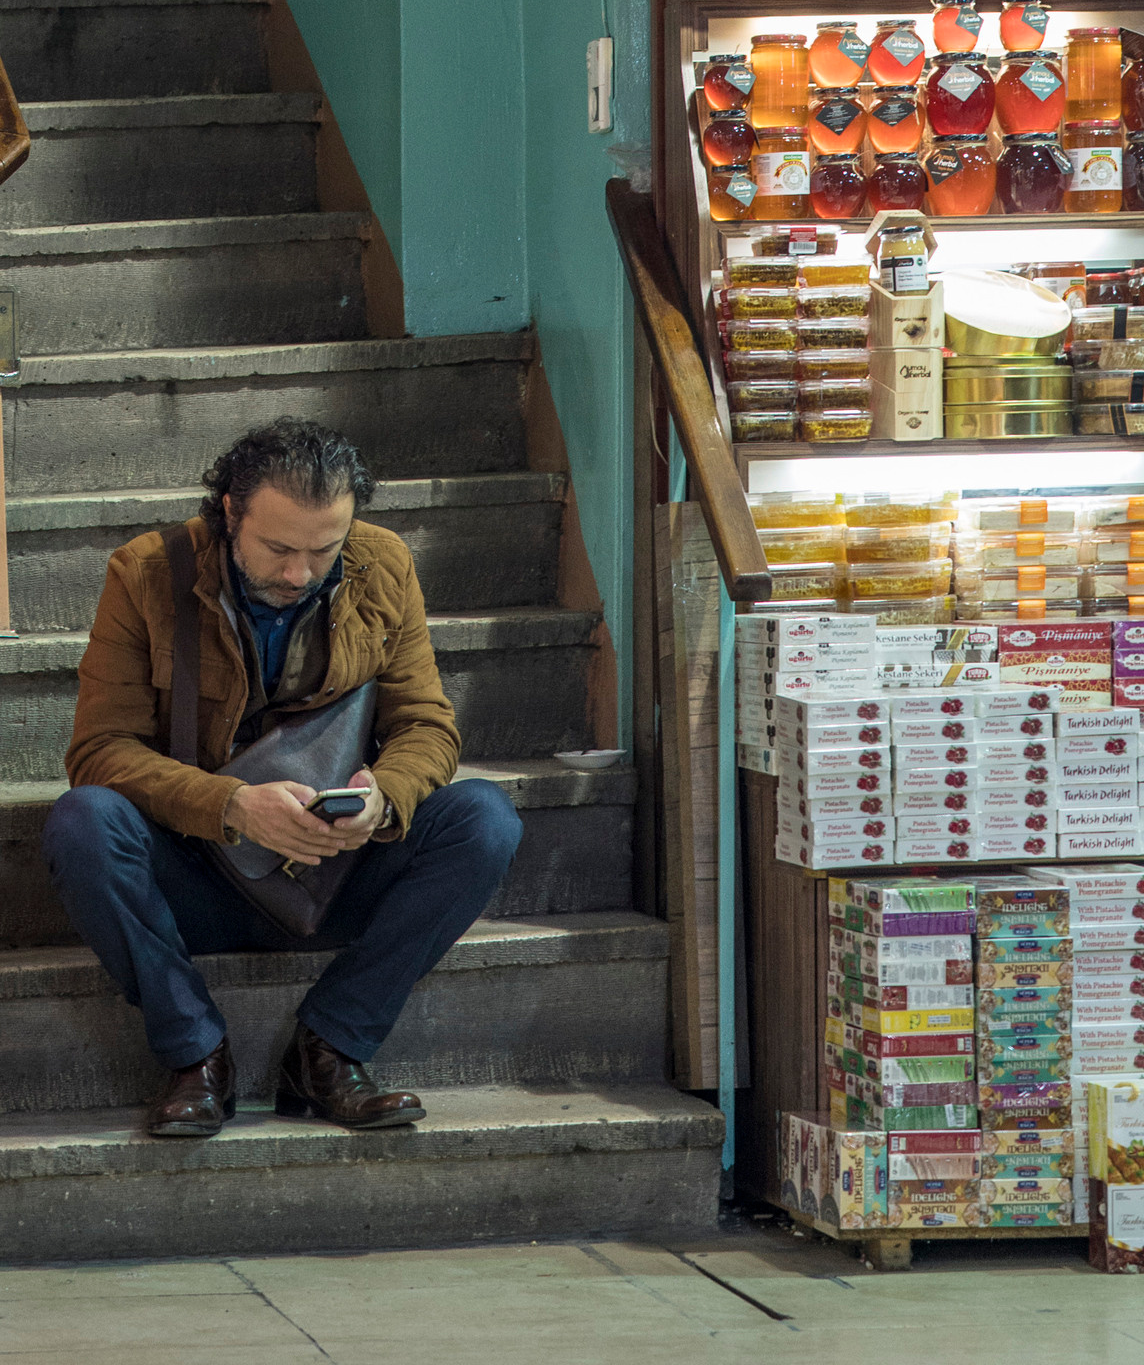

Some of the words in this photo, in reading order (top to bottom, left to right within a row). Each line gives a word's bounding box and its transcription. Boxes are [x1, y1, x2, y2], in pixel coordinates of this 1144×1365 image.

[875, 634, 911, 644] Kestane
[877, 670, 914, 679] Kestane
[1021, 665, 1091, 677] Pişmaniye
[1067, 717, 1101, 728] Turkish
[1103, 716, 1134, 728] Delight
[1063, 765, 1097, 776] Turkish
[1099, 764, 1131, 777] Delight
[1064, 789, 1098, 800] Turkish
[1100, 788, 1132, 802] Delight
[1066, 814, 1100, 825] Turkish
[1102, 813, 1134, 825] Delight
[1068, 839, 1102, 849] Turkish
[1104, 838, 1135, 850] Delight
[1075, 880, 1093, 888] With
[1094, 879, 1127, 888] Pistachio
[1078, 888, 1124, 897] Pomegranate
[1077, 906, 1094, 914] With
[1095, 905, 1126, 913] Pistachio
[1079, 913, 1124, 923] Pomegranate
[1079, 932, 1096, 940] With
[1097, 931, 1128, 939] Pistachio
[1081, 940, 1125, 949] Pomegranate
[1075, 956, 1092, 964] With
[1093, 956, 1124, 964] Pistachio
[1077, 965, 1122, 974] Pomegranate
[1075, 981, 1092, 989] With
[1093, 981, 1124, 989] Pistachio
[1077, 989, 1121, 999] Pomegranate
[1076, 1006, 1093, 1014] With
[1094, 1005, 1125, 1014] Pistachio
[1078, 1014, 1122, 1023] Pomegranate
